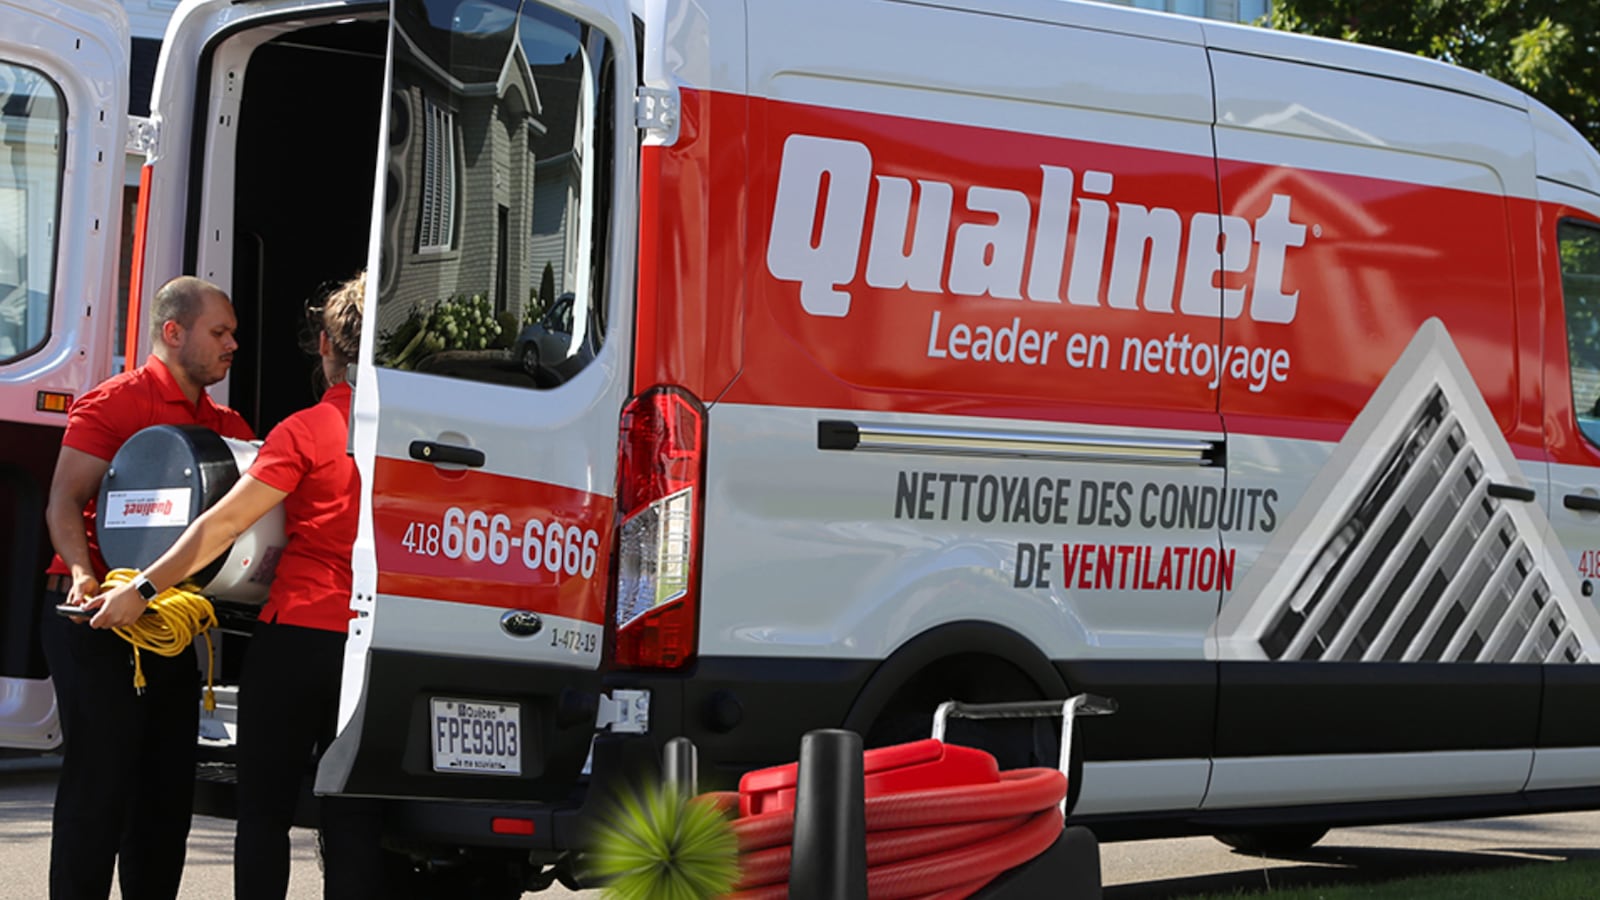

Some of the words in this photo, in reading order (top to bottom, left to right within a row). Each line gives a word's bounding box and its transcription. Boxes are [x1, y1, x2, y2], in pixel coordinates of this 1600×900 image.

[766, 133, 1307, 324] Qualinet
[927, 311, 1058, 366] Leader
[1066, 332, 1109, 369] en
[1120, 332, 1291, 393] nettoyage
[122, 500, 173, 516] Qualinet
[894, 471, 1071, 525] NETTOYAGE
[1077, 480, 1133, 528] DES
[1139, 483, 1278, 532] CONDUITS
[1014, 543, 1054, 589] DE
[1062, 543, 1236, 592] VENTILATION
[551, 628, 597, 653] 1-472-19
[436, 716, 518, 757] FPE9303
